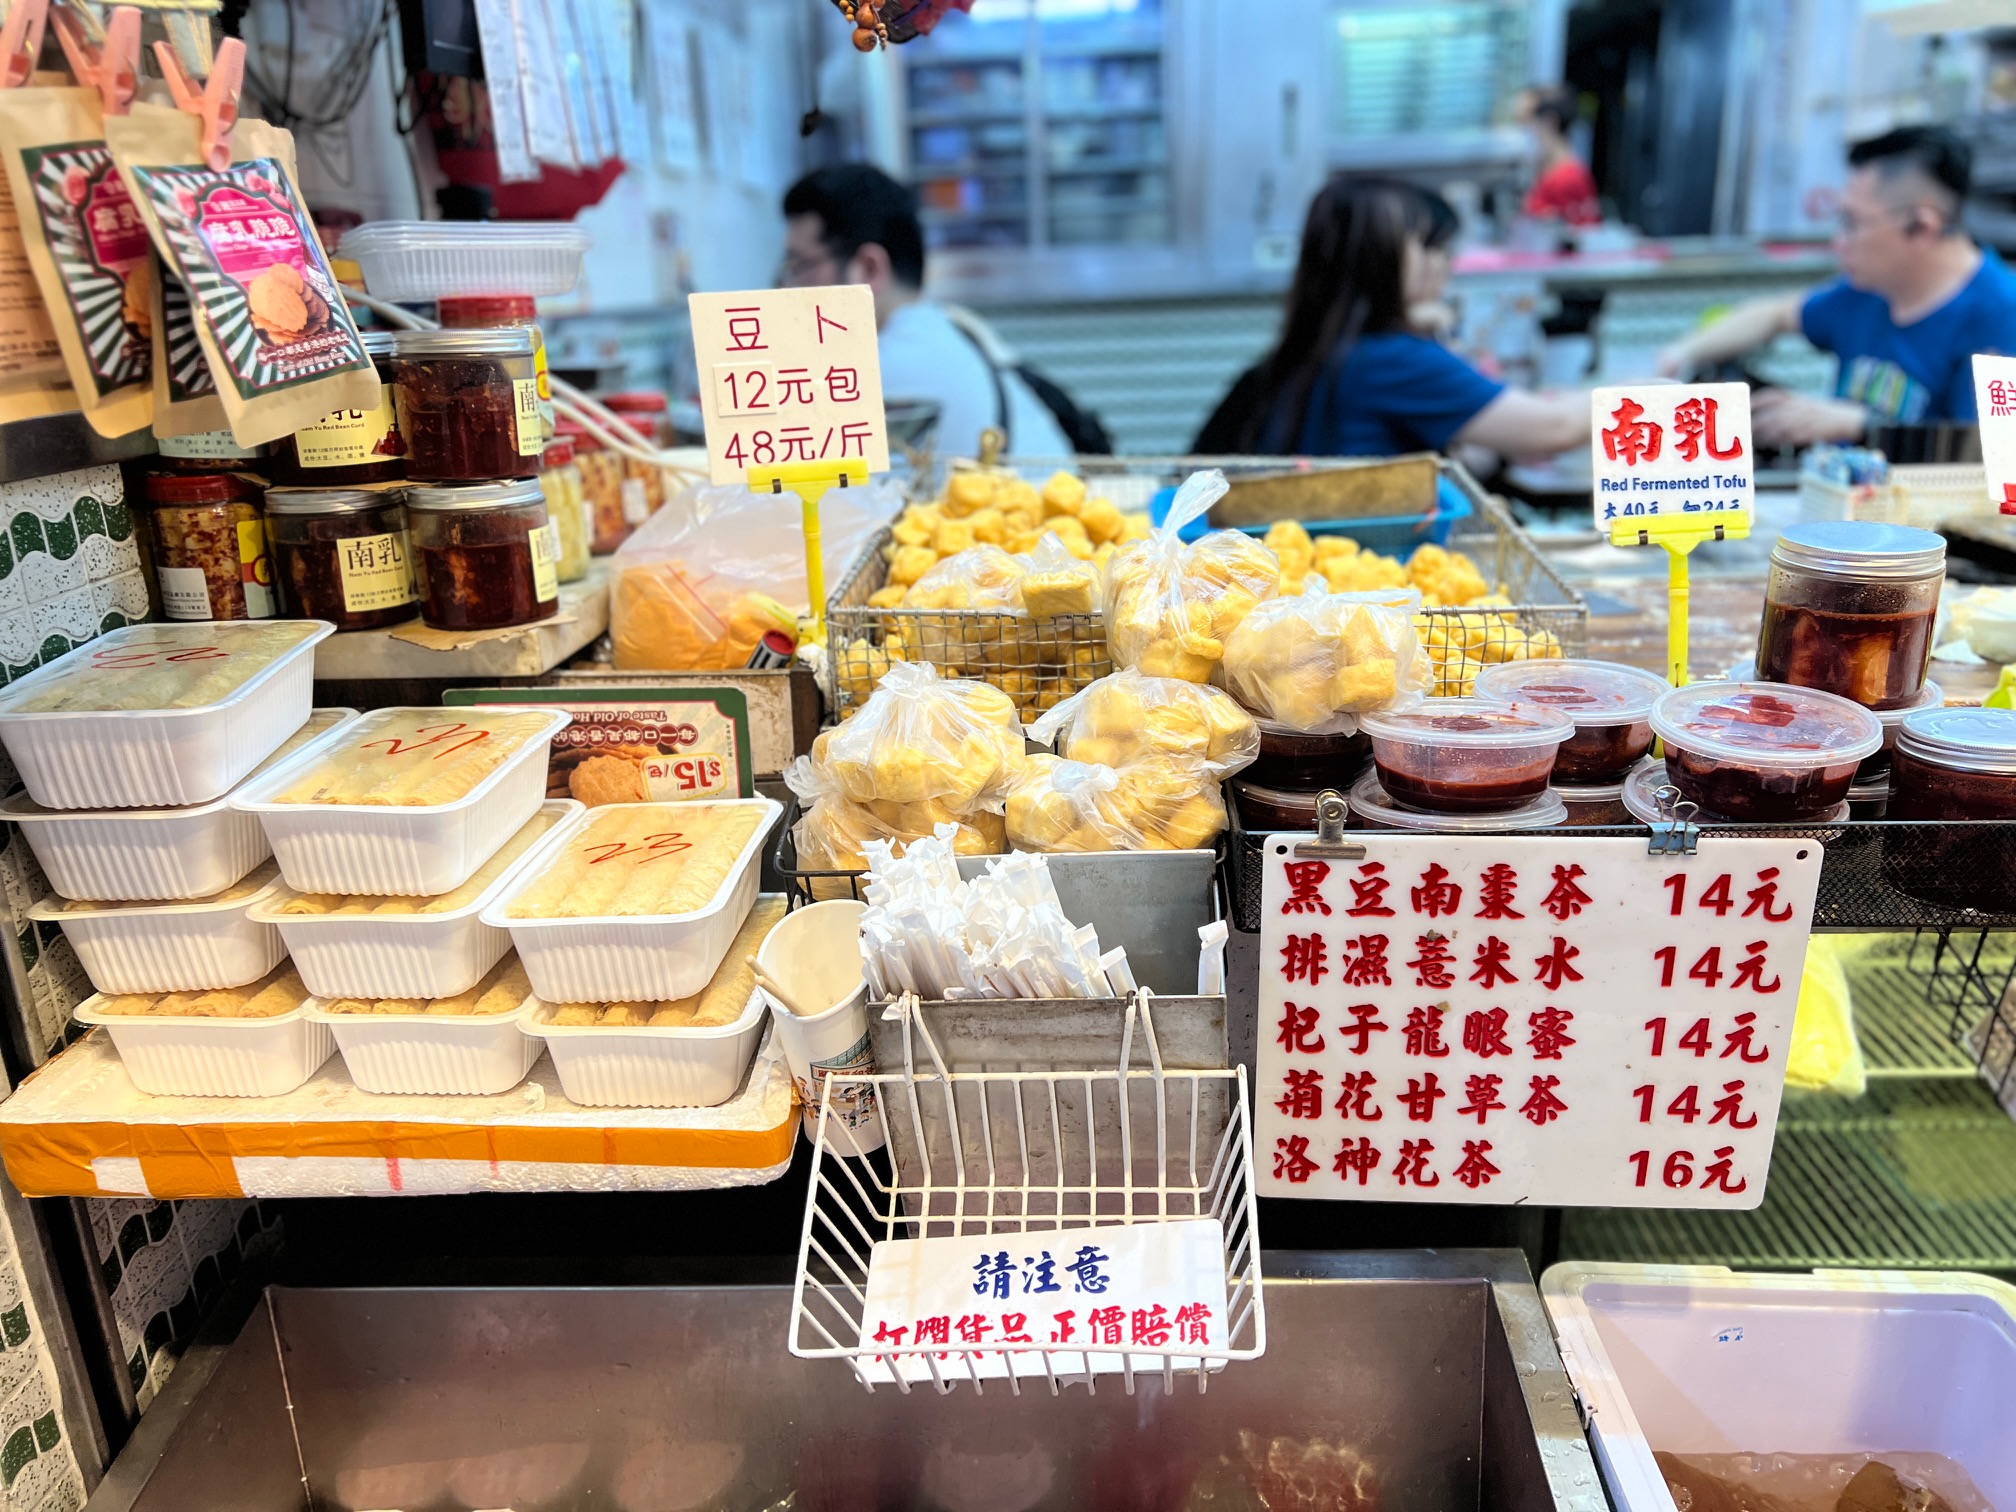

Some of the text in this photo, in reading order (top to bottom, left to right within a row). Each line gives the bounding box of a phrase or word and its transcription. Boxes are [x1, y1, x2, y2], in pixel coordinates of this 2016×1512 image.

[724, 366, 861, 409] 12元包
[725, 421, 873, 469] 48元/斤
[1601, 397, 1744, 467] 南乳
[1601, 475, 1747, 492] Red Fermented Tofu
[344, 537, 402, 570] 南乳
[595, 711, 616, 722] Old
[617, 710, 630, 721] of
[633, 710, 667, 722] Taste
[1281, 861, 1794, 923] 黑豆南棗茶 14元
[1279, 932, 1782, 995] 排濕薏米水 14元
[1276, 1001, 1770, 1064] 杞子龍眼蜜 14元
[1274, 1069, 1759, 1130] 菊花甘草茶 14元
[1272, 1135, 1748, 1195] 洛神花茶 16元
[972, 1246, 1111, 1299] 請注意
